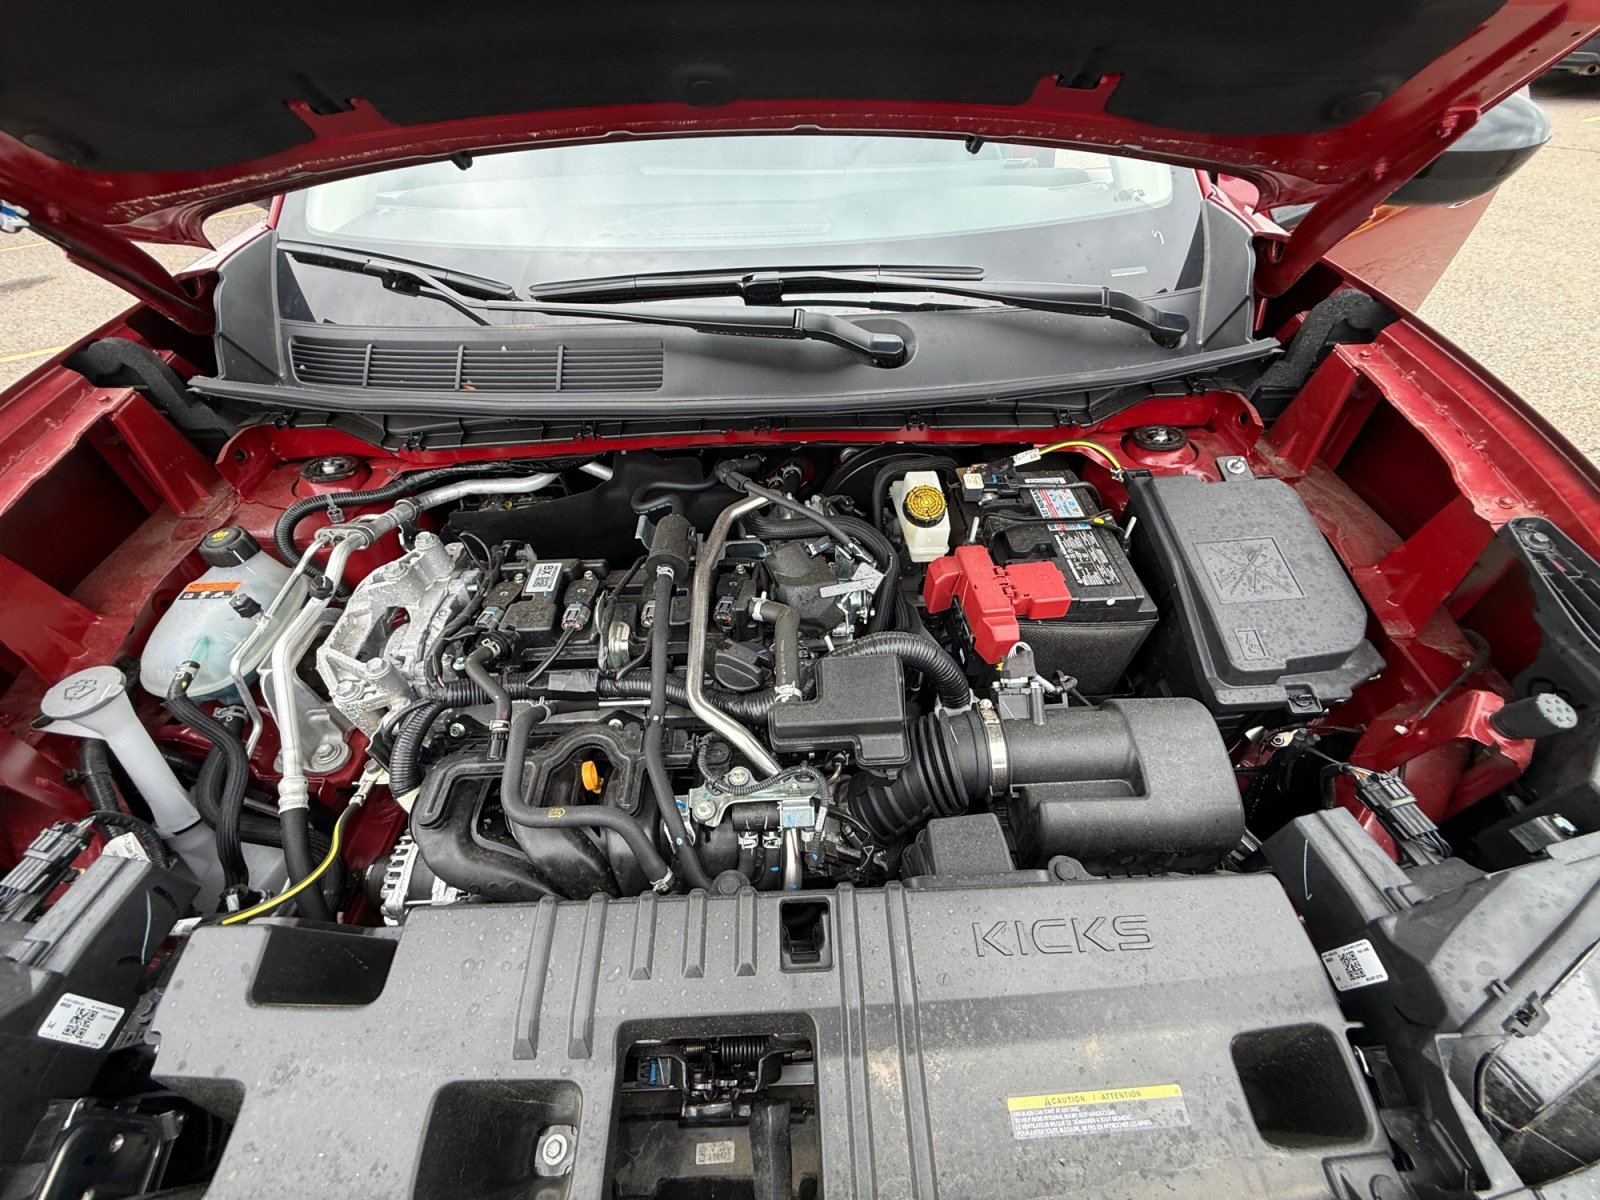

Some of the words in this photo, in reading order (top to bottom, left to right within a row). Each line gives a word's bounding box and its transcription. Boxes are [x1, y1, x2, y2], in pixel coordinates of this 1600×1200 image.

[541, 565, 554, 576] BX
[972, 915, 1155, 957] KICKS
[1051, 1095, 1086, 1105] CAUTION
[1101, 1090, 1142, 1100] ATTENTION
